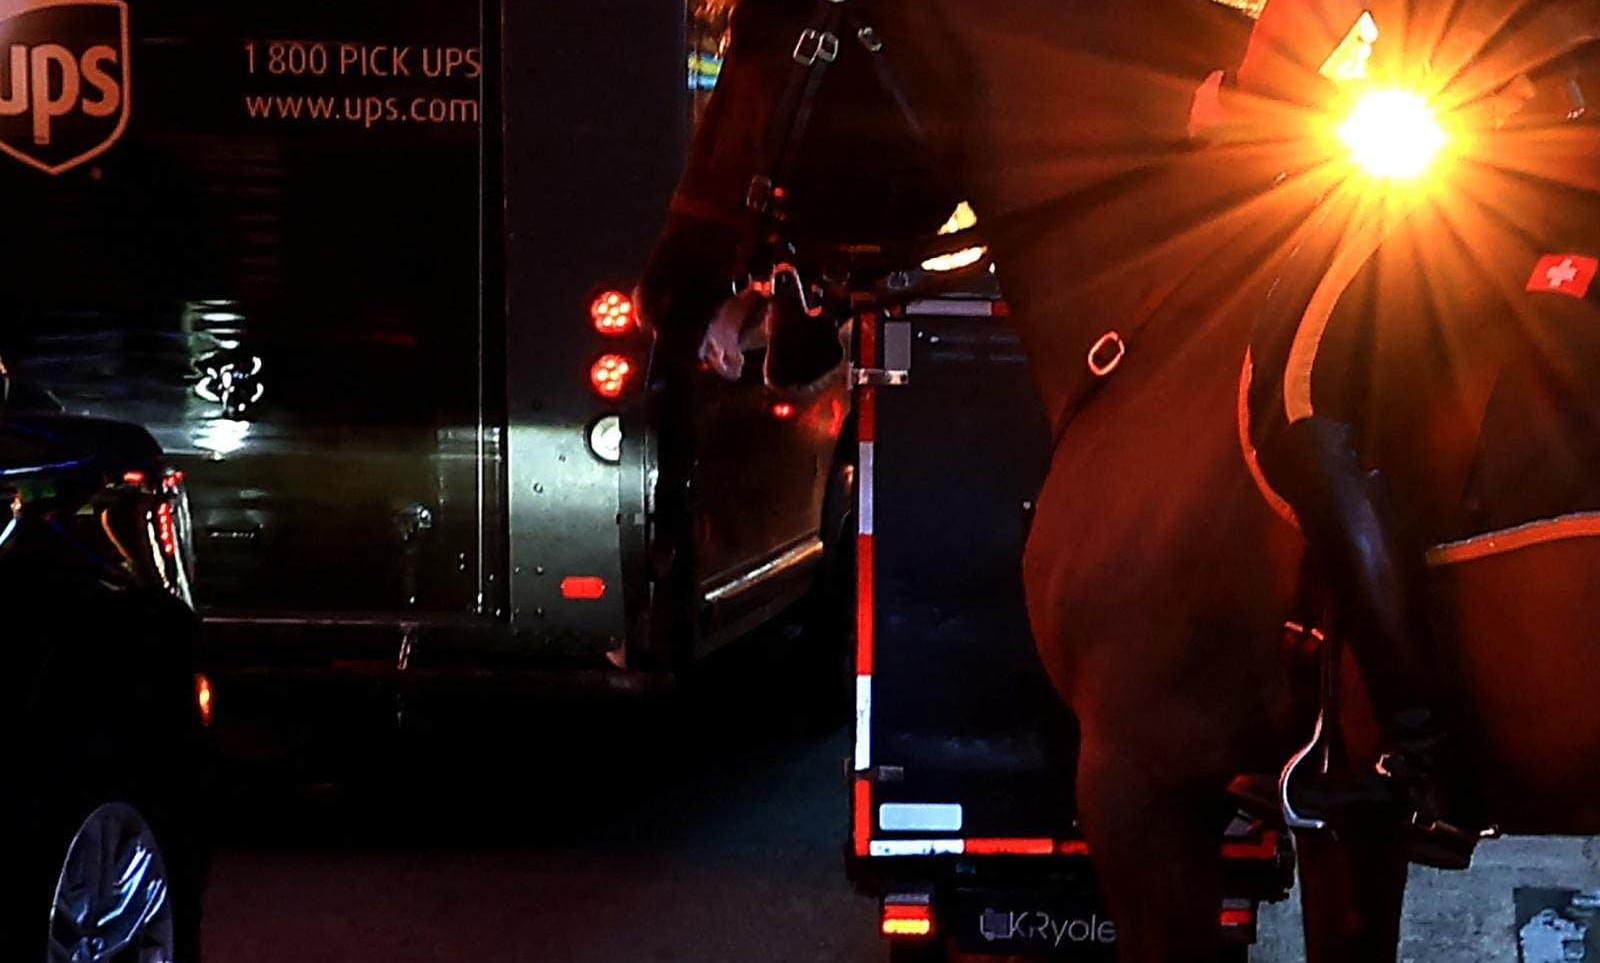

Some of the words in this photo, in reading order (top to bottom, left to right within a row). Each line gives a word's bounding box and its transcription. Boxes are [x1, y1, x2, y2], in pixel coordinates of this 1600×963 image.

[245, 43, 254, 73] 1
[268, 43, 327, 74] 800
[341, 46, 409, 76] PICK
[423, 47, 481, 77] UPS
[245, 95, 478, 128] www.ups.com
